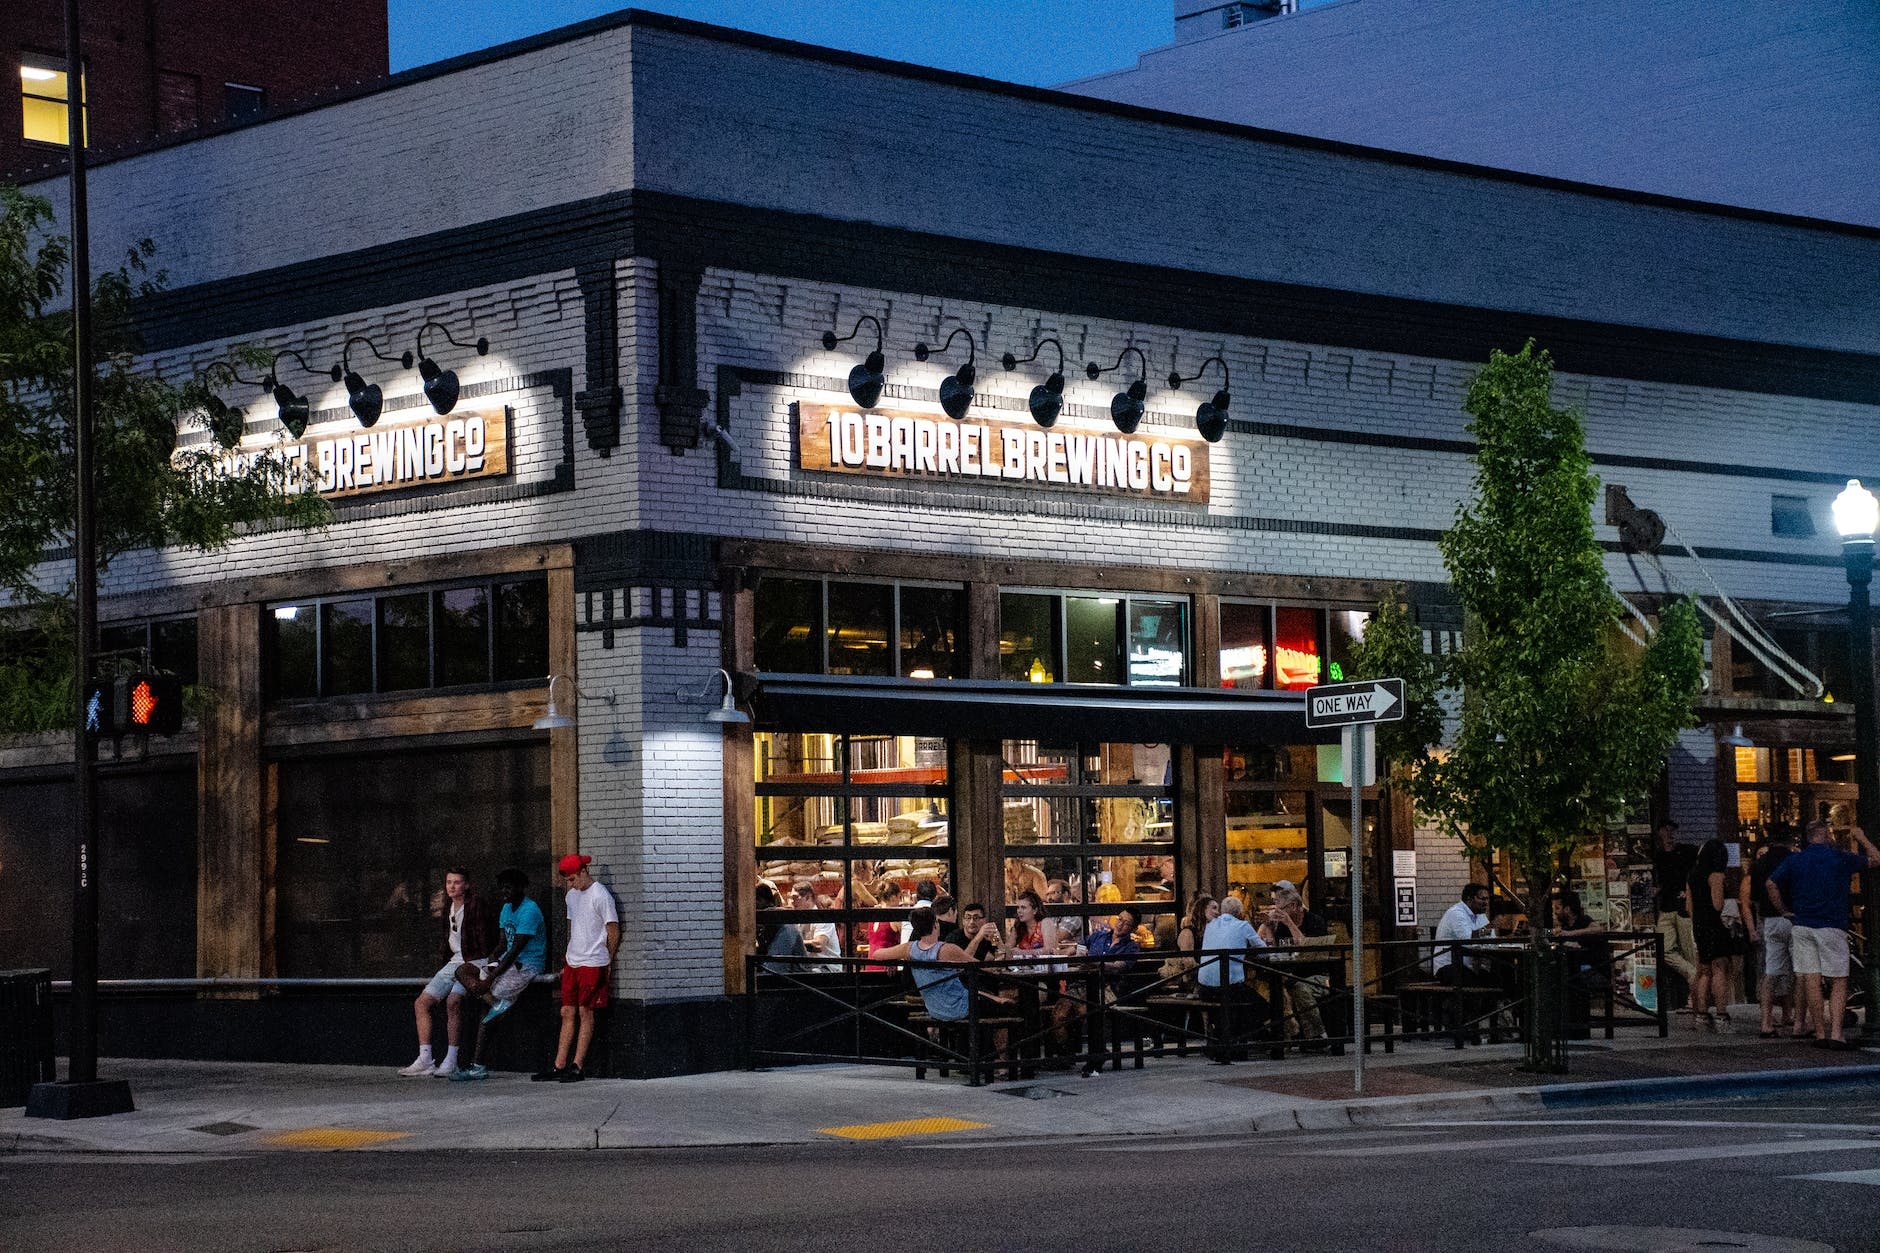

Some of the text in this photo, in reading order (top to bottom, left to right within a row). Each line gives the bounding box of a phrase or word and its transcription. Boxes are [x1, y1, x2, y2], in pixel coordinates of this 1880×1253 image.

[317, 424, 443, 491] BREWING
[446, 417, 485, 472] CO
[827, 411, 1192, 493] 10 BARREL BREWING CO
[1316, 694, 1373, 714] ONE WAY
